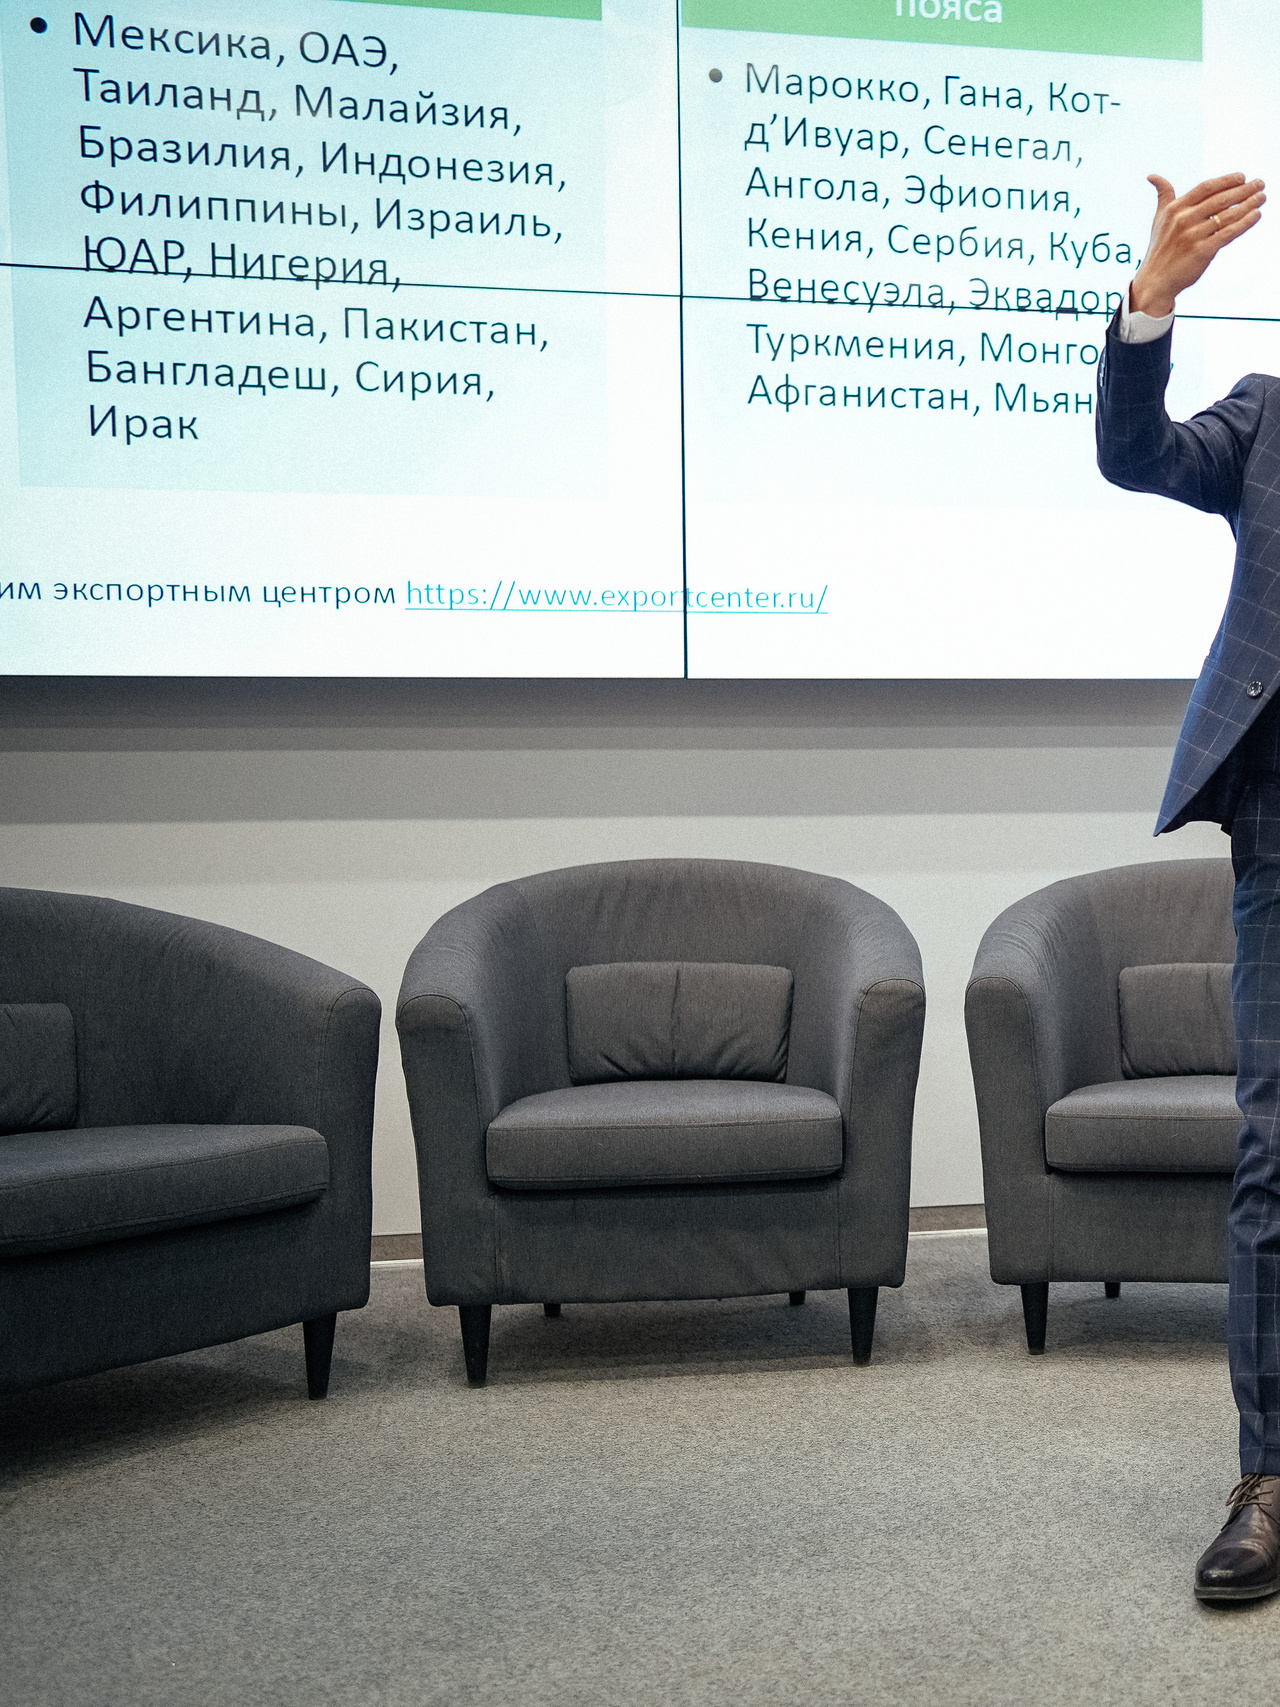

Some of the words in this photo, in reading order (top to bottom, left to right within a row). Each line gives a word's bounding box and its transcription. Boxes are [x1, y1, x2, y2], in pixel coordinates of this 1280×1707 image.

[896, 0, 1003, 23] пояса
[73, 12, 285, 66] Мексика,
[299, 30, 398, 73] ОАЭ,
[73, 67, 278, 121] Таиланд,
[295, 84, 522, 136] Малайзия,
[746, 63, 930, 109] Марокко,
[943, 77, 1034, 114] Гана,
[1049, 83, 1121, 114] Кот-
[80, 125, 304, 177] Бразилия,
[322, 141, 567, 191] Индонезия,
[924, 126, 1083, 167] Сенегал,
[80, 180, 359, 232] Филиппины,
[375, 197, 563, 243] Израиль,
[745, 167, 890, 209] Ангола,
[904, 174, 1082, 217] Эфиопия,
[83, 236, 193, 283] ЮАР,
[210, 243, 401, 293] Нигерия,
[747, 218, 873, 258] Кения,
[887, 224, 1035, 264] Сербия,
[1049, 232, 1142, 269] Куба,
[749, 269, 956, 312] Венесуэла,
[84, 296, 327, 343] Аргентина,
[343, 307, 548, 350] Пакистан,
[747, 323, 965, 365] Туркмения,
[87, 351, 339, 396] Бангладеш,
[355, 361, 494, 400] Сирия,
[747, 374, 979, 417] Афганистан,
[995, 382, 1097, 415] Мьян
[89, 405, 198, 445] Ирак
[53, 583, 251, 607] экспортным
[263, 586, 396, 609] центром
[406, 580, 829, 614] https://www.exportcenter.ru/
